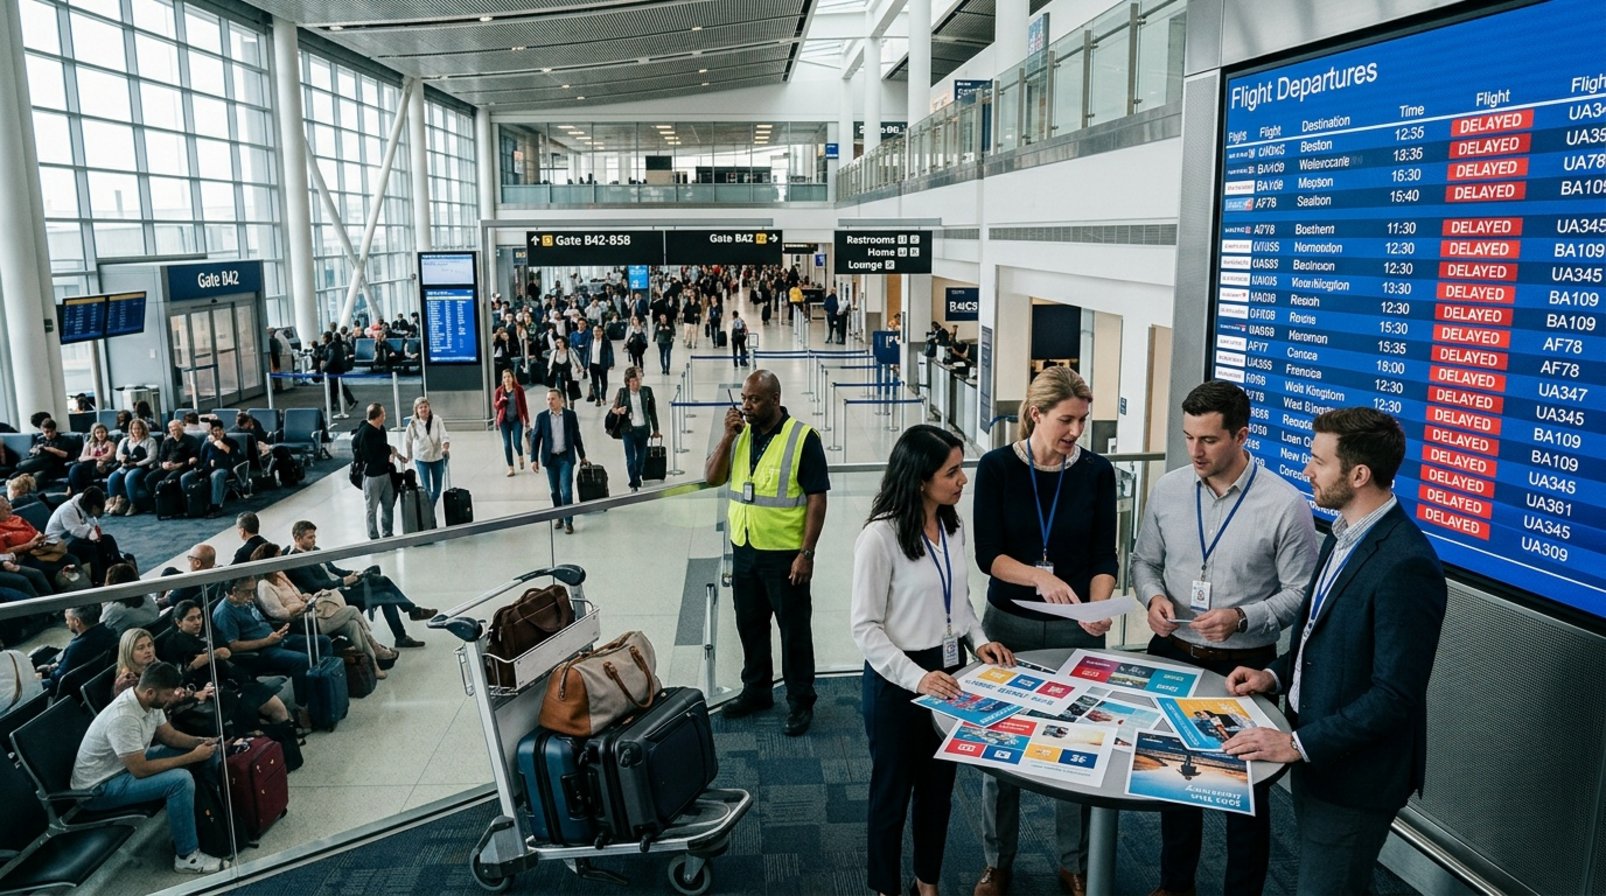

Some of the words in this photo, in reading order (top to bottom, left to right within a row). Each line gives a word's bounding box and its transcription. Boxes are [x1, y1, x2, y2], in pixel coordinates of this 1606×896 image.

[1231, 83, 1273, 111] Flight
[1277, 62, 1378, 102] Departures
[1301, 115, 1351, 132] Destination
[1399, 104, 1425, 118] Time
[1476, 89, 1511, 107] Flight
[1459, 113, 1522, 134] DELAYED
[1458, 136, 1520, 156] DELAYED
[1456, 160, 1518, 178] DELAYED
[1454, 184, 1515, 200] DELAYED
[709, 233, 733, 243] Gate
[1387, 221, 1417, 234] 11:30
[1451, 220, 1512, 234] DELAYED
[1557, 218, 1606, 233] UA345
[555, 235, 582, 246] Gate
[846, 235, 895, 245] Restrooms
[867, 247, 895, 257] Home
[1385, 242, 1415, 255] 12:30
[1449, 242, 1509, 256] DELAYED
[1554, 243, 1605, 258] BA109
[848, 260, 882, 272] Lounge
[1383, 262, 1413, 275] 12:30
[1447, 264, 1507, 279] DELAYED
[1551, 267, 1603, 283] UA345
[198, 272, 220, 288] Gate
[221, 270, 239, 286] B42
[1382, 282, 1412, 295] 13:30
[1445, 285, 1505, 301] DELAYED
[1549, 290, 1599, 307] BA109
[1381, 301, 1410, 315] 12:30
[1443, 306, 1502, 323] DELAYED
[1546, 314, 1596, 331] BA109
[1379, 321, 1408, 335] 15:30
[1441, 327, 1500, 345] DELAYED
[1542, 337, 1583, 354] AF78
[1377, 340, 1407, 355] 15:35
[1439, 348, 1498, 367] DELAYED
[1540, 360, 1580, 378] AF78
[1438, 368, 1496, 388] DELAYED
[1538, 383, 1588, 402] UA347
[1374, 378, 1403, 394] 12:30
[1436, 388, 1493, 409] DELAYED
[1536, 405, 1585, 426] UA345
[1373, 398, 1402, 414] 12:30
[1434, 408, 1491, 431] DELAYED
[1533, 427, 1582, 449] BA109
[1432, 429, 1489, 452] DELAYED
[1531, 449, 1579, 472] BA109
[1430, 449, 1487, 473] DELAYED
[1529, 471, 1576, 495] UA345
[1428, 469, 1485, 493] DELAYED
[1526, 493, 1572, 517] UA361
[1426, 488, 1483, 514] DELAYED
[1523, 515, 1571, 539] UA345
[1425, 508, 1480, 535] DELAYED
[1521, 536, 1568, 562] UA309
